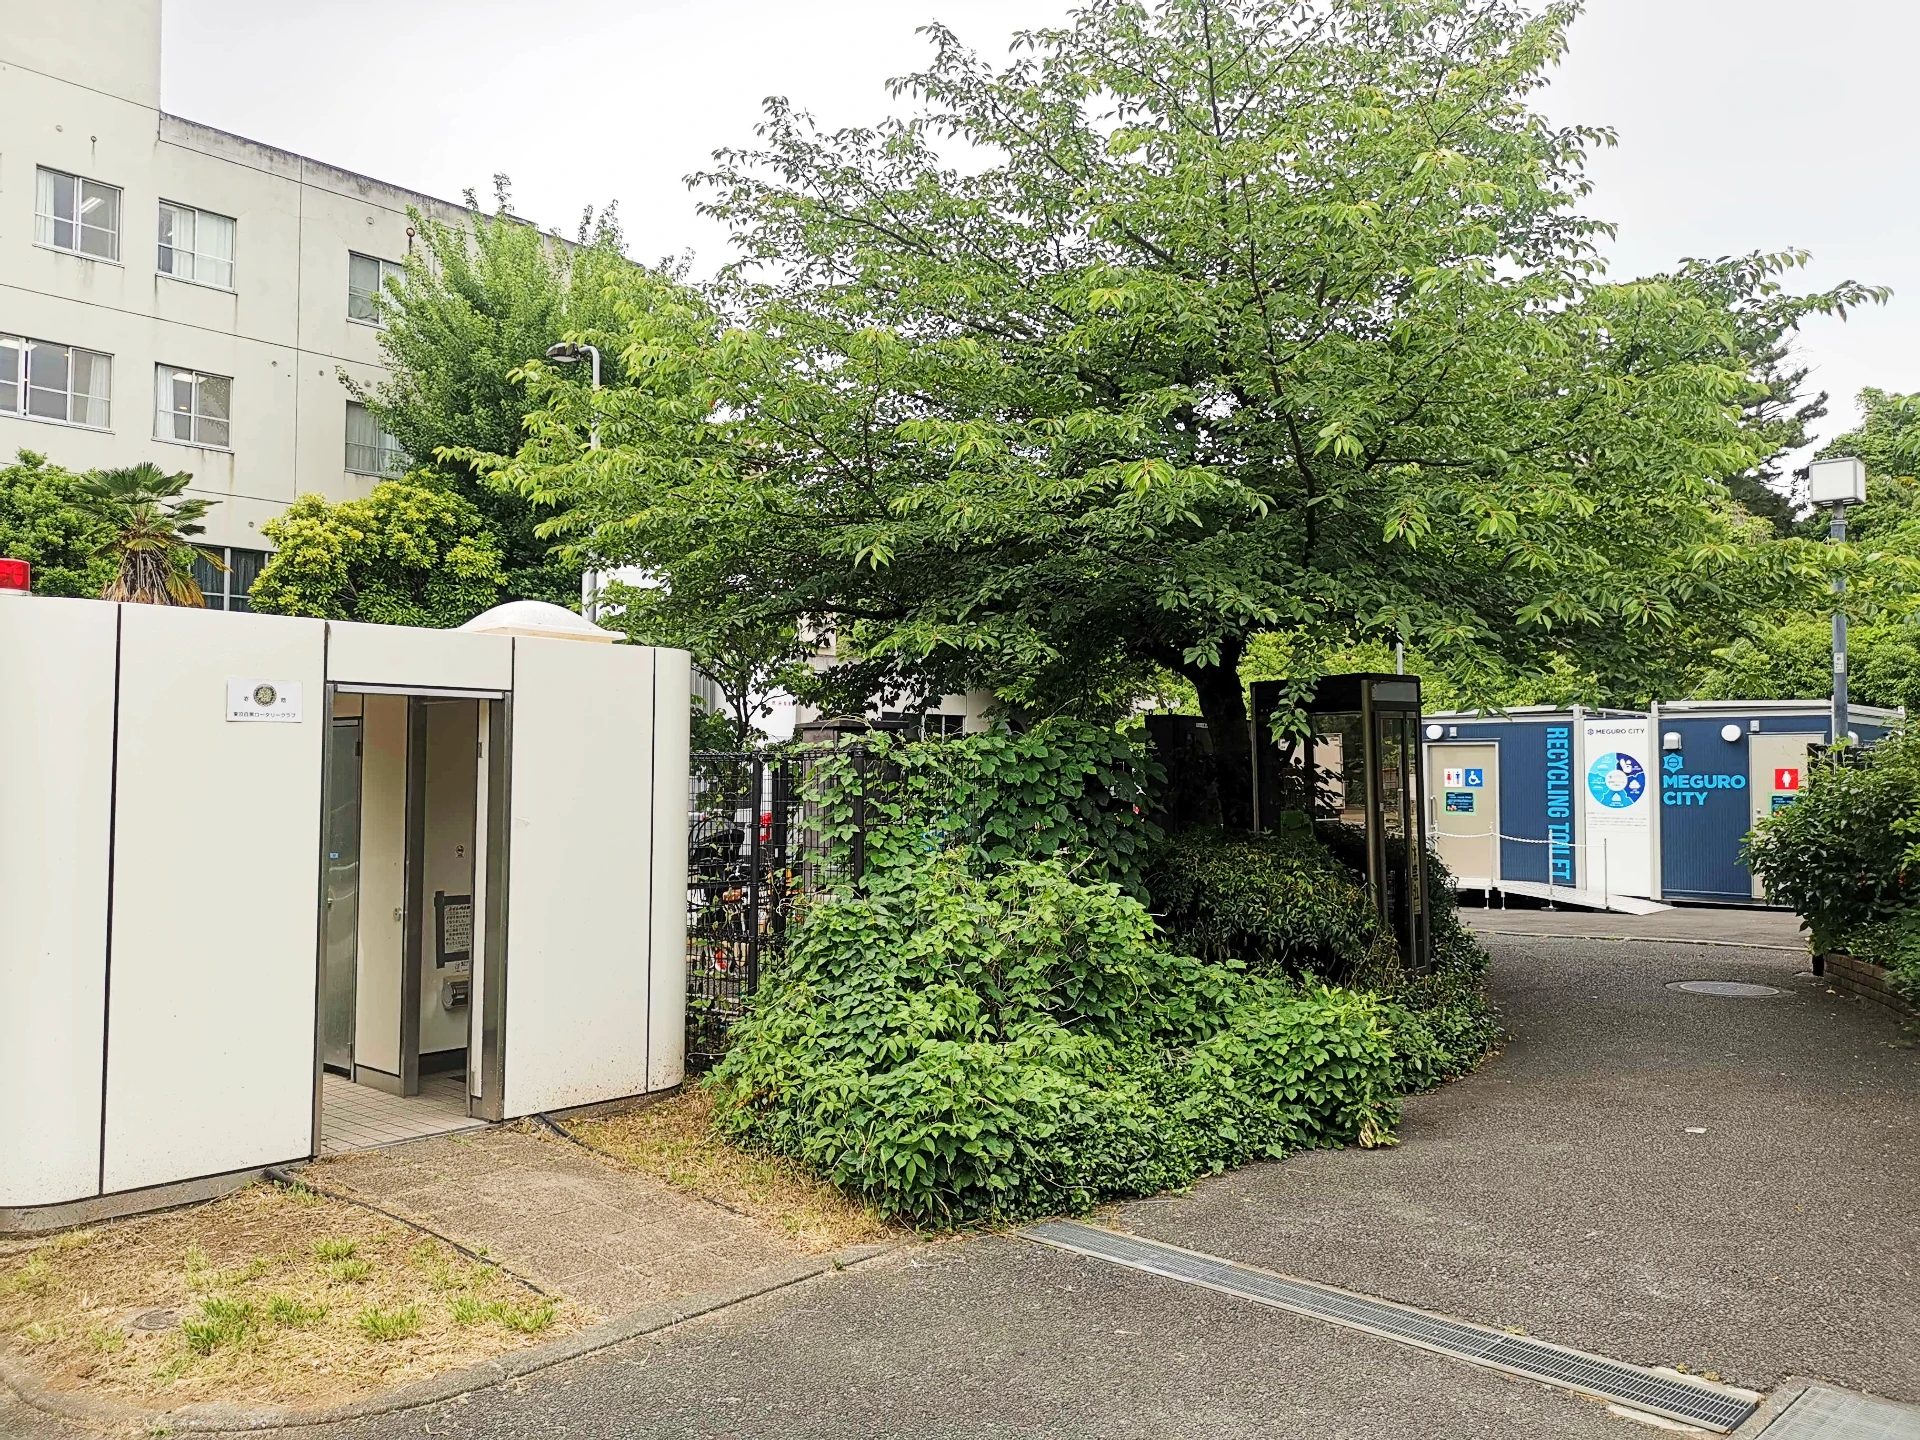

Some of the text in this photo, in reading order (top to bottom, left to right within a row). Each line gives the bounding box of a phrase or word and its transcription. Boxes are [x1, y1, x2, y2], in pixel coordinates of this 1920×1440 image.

[1547, 727, 1570, 818] RECYCLING
[1663, 775, 1745, 789] MEGURO
[1663, 791, 1707, 806] CITY
